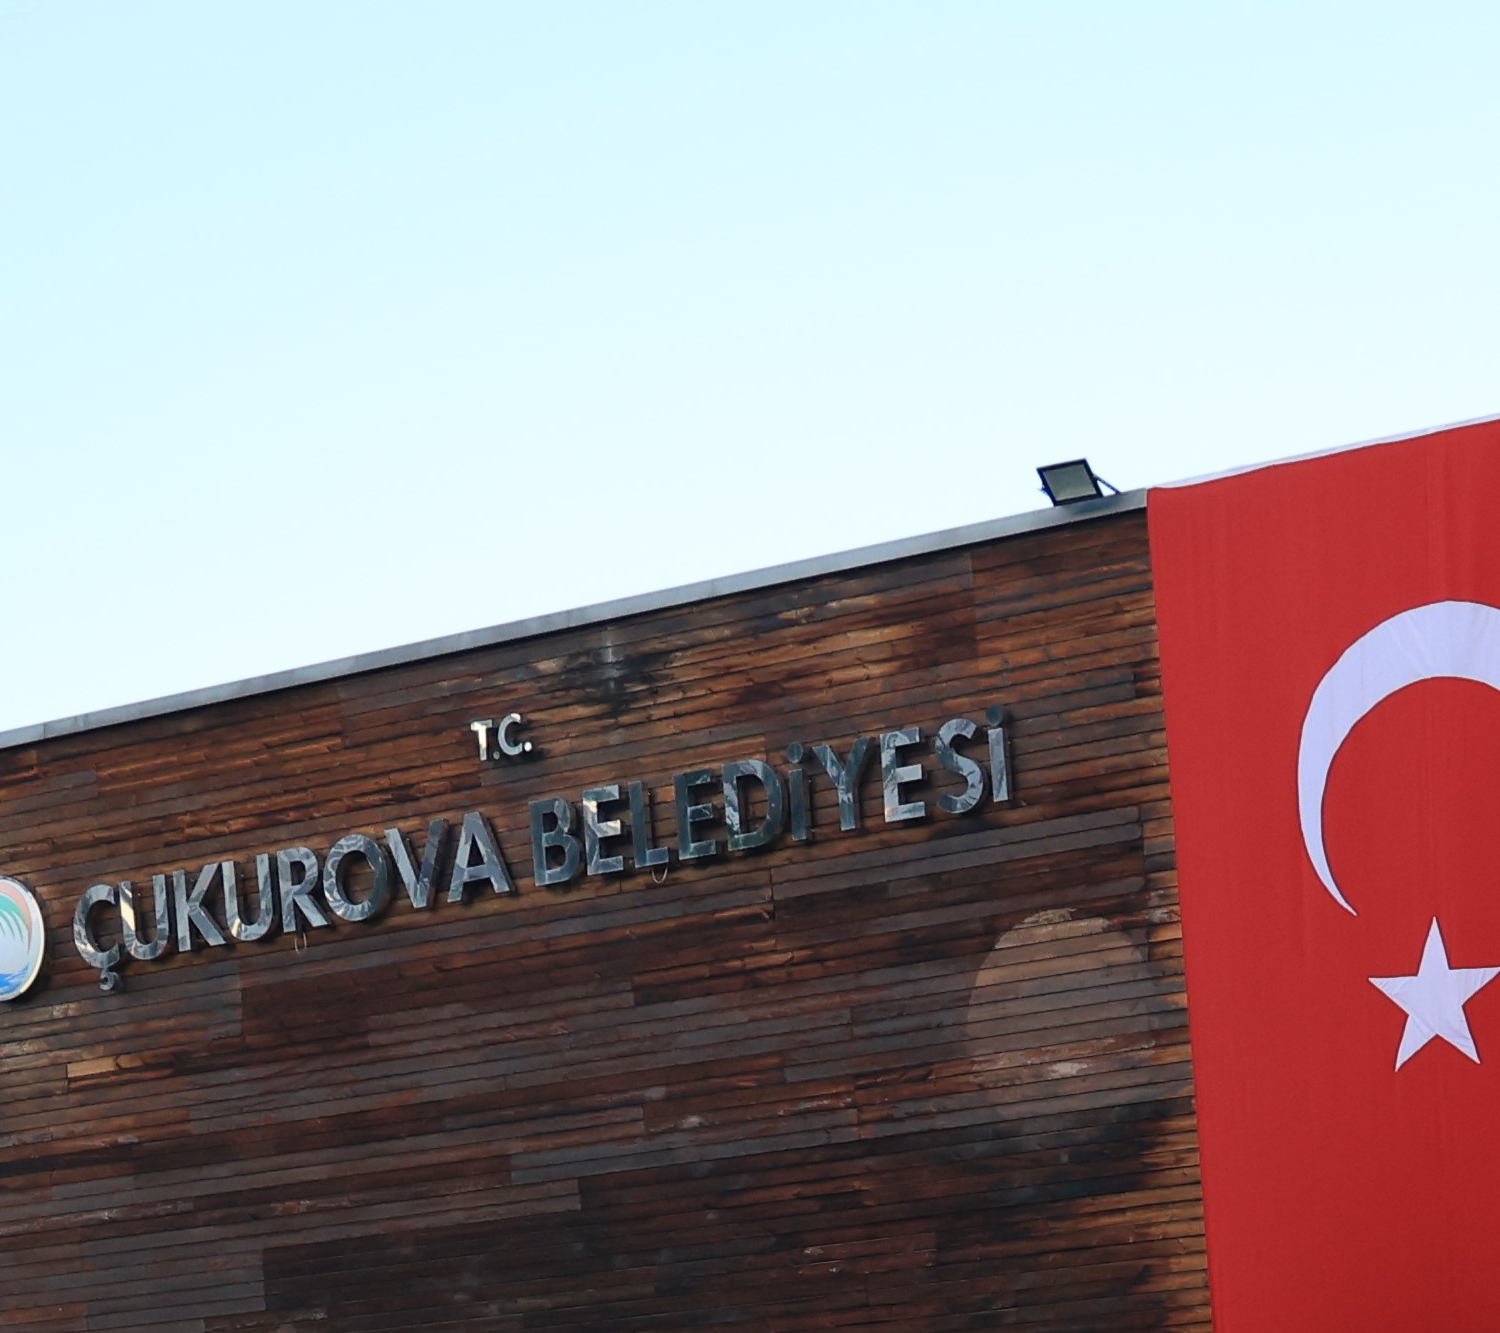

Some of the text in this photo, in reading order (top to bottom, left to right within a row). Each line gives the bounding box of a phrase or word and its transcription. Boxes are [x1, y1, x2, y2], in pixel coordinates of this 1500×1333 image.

[470, 712, 533, 762] T.C.
[73, 704, 1009, 991] ÇUKUROVA BELEDİYESİ
